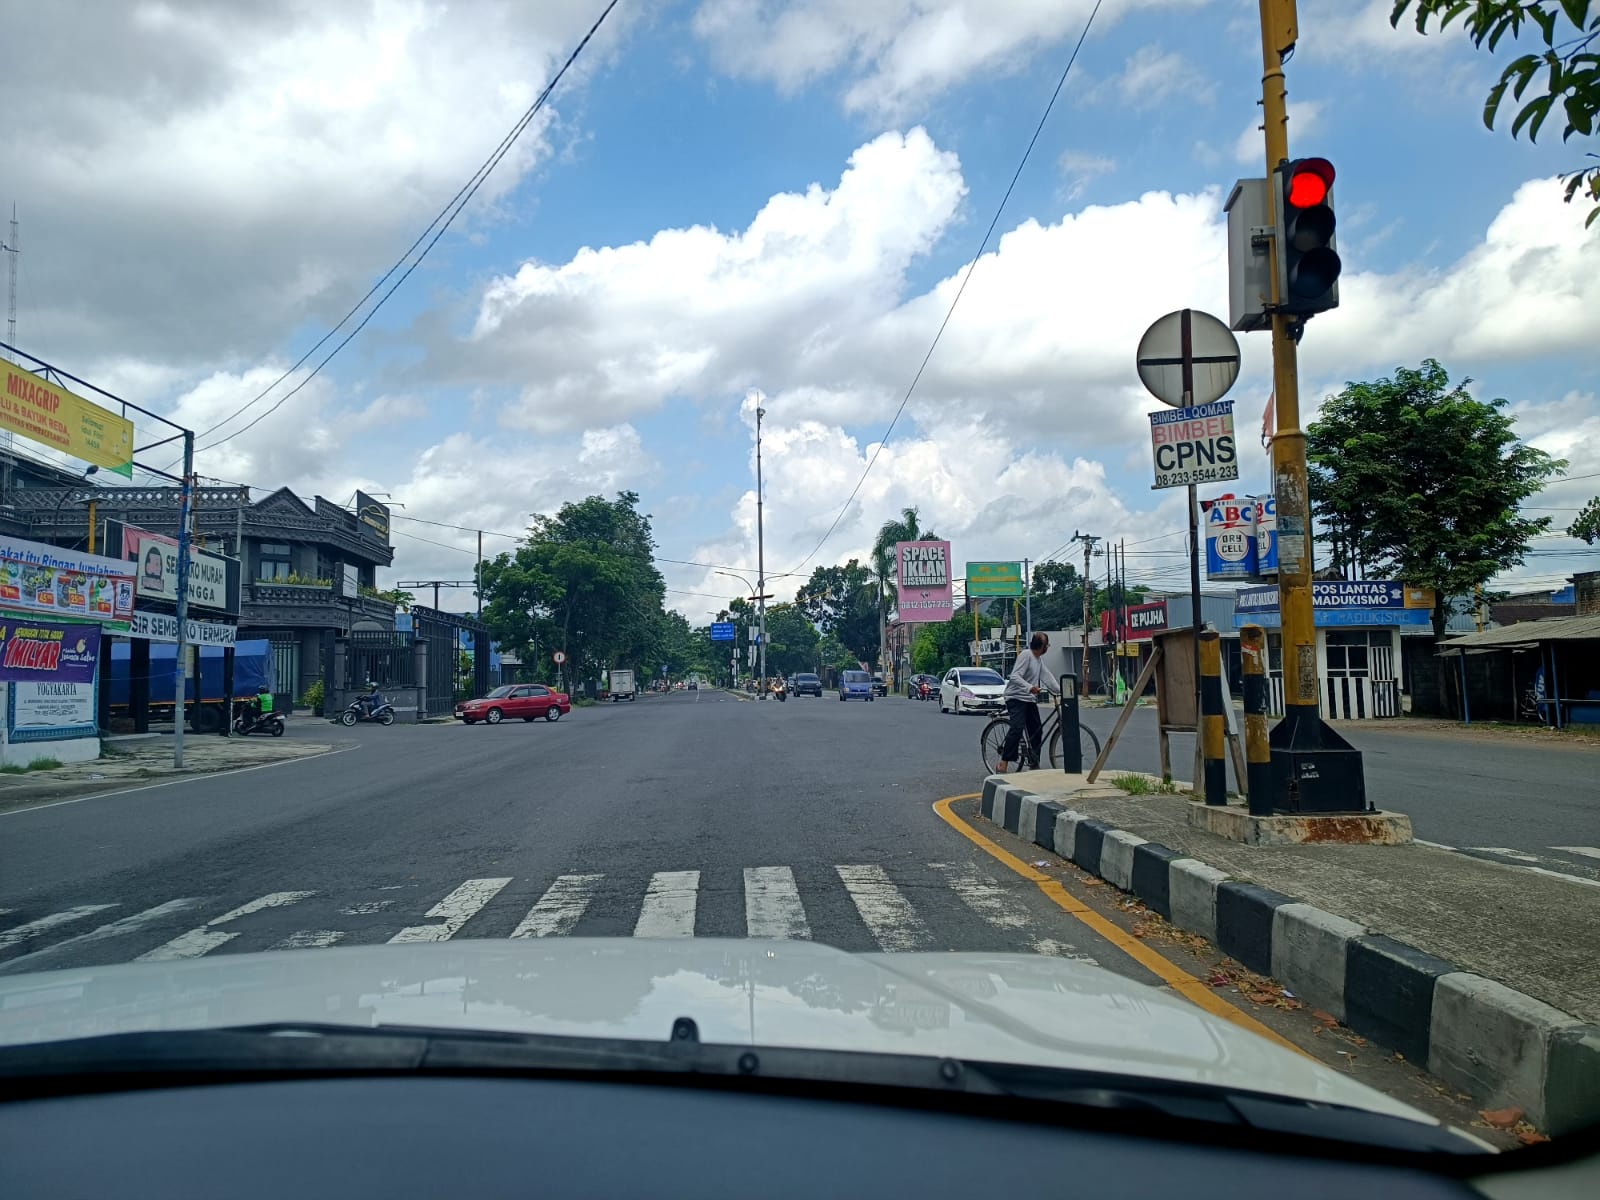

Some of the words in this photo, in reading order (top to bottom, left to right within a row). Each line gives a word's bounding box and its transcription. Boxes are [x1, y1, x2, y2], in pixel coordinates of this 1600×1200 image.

[7, 372, 60, 414] MIXAGRIP
[1152, 408, 1191, 424] BIMBEL
[1192, 402, 1231, 418] QOMAH
[1154, 417, 1232, 443] BIMBEL
[1157, 436, 1235, 471] CPNS
[1210, 507, 1252, 522] ABC
[1222, 534, 1242, 543] DRY
[0, 546, 24, 560] akat
[903, 546, 945, 561] SPACE
[1221, 544, 1243, 553] CELL
[201, 563, 224, 585] MURAH
[903, 560, 946, 577] IKLAN
[903, 577, 947, 586] DISEWAKAN
[1313, 584, 1337, 595] POS
[1339, 583, 1387, 594] LANTAS
[1312, 595, 1389, 606] MADUKISMO
[1139, 609, 1165, 627] PUJHA
[37, 682, 77, 696] YOGYAKARTA
